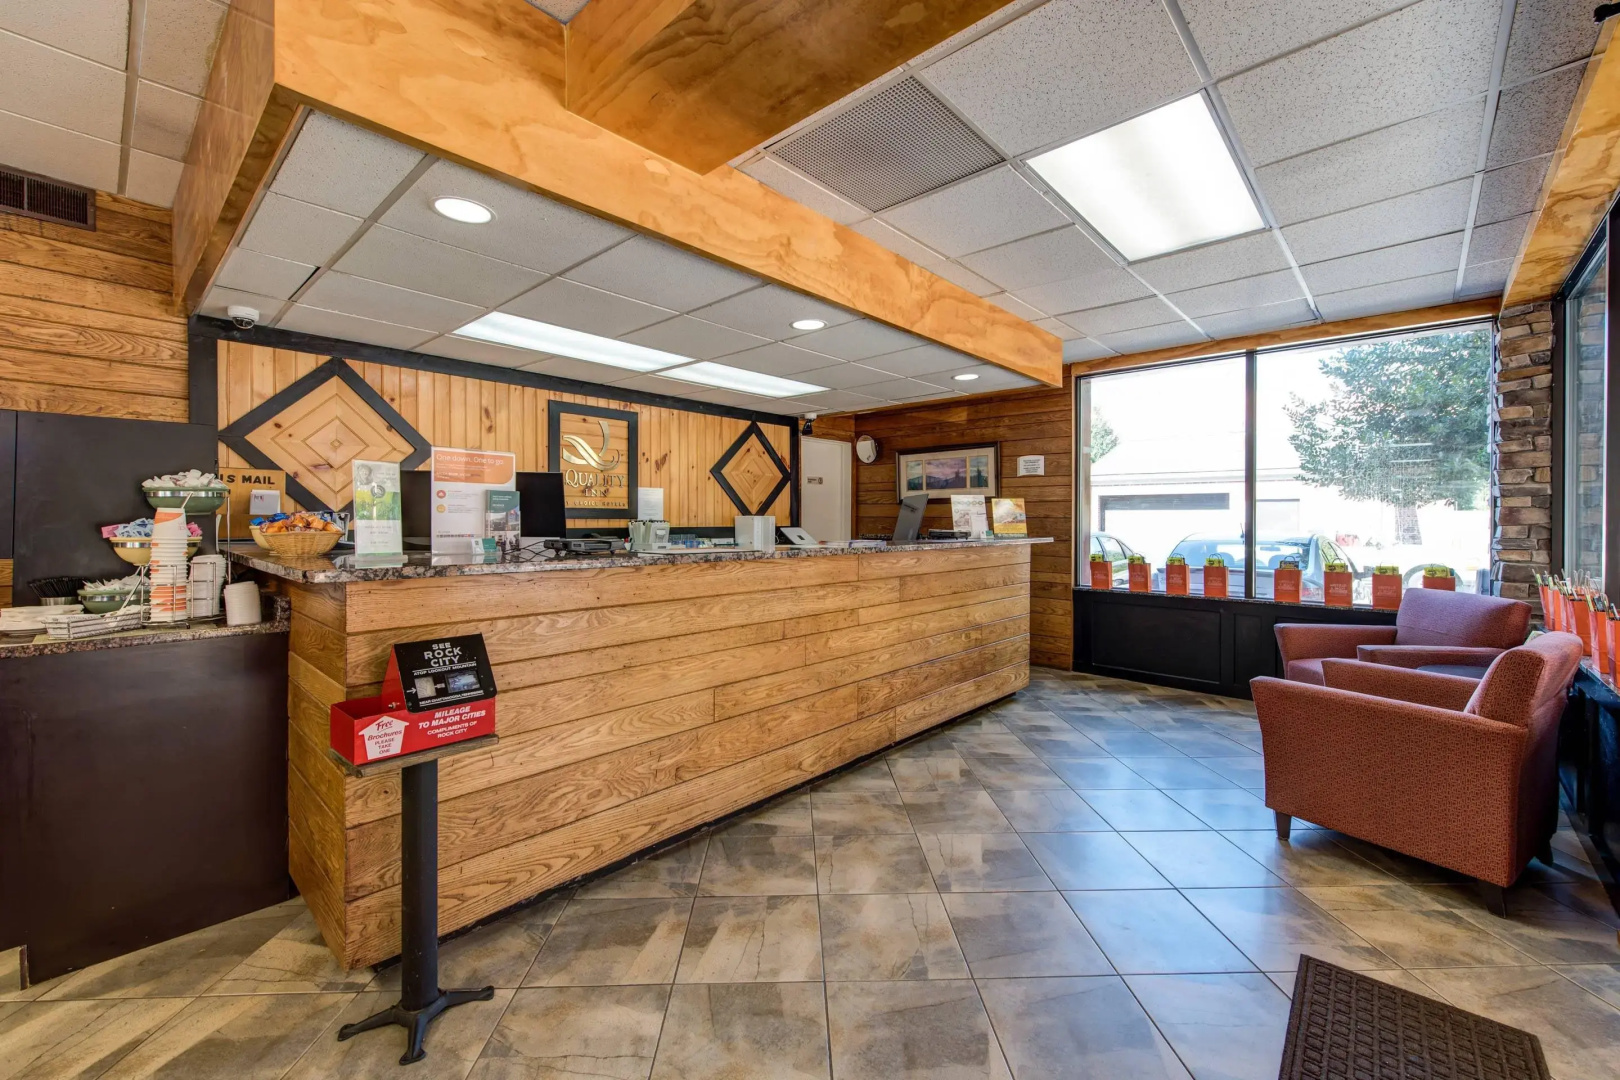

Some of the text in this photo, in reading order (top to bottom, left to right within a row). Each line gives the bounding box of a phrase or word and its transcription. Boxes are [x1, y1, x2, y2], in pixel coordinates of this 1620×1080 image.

[241, 475, 275, 485] MAIL
[565, 468, 625, 488] QUALITY
[584, 488, 610, 498] INN
[432, 642, 452, 650] SEE
[423, 646, 463, 660] ROCK
[430, 655, 460, 667] CITY
[428, 666, 451, 674] LOOKOUT
[452, 662, 477, 670] MOUNTAIN
[434, 705, 471, 719] MILEAGE
[375, 720, 394, 731] Free
[418, 710, 486, 730] TO MAJOR CITIES
[427, 722, 469, 735] COMPLIMENTS
[367, 729, 402, 741] Brochures
[374, 737, 395, 746] PLEASE
